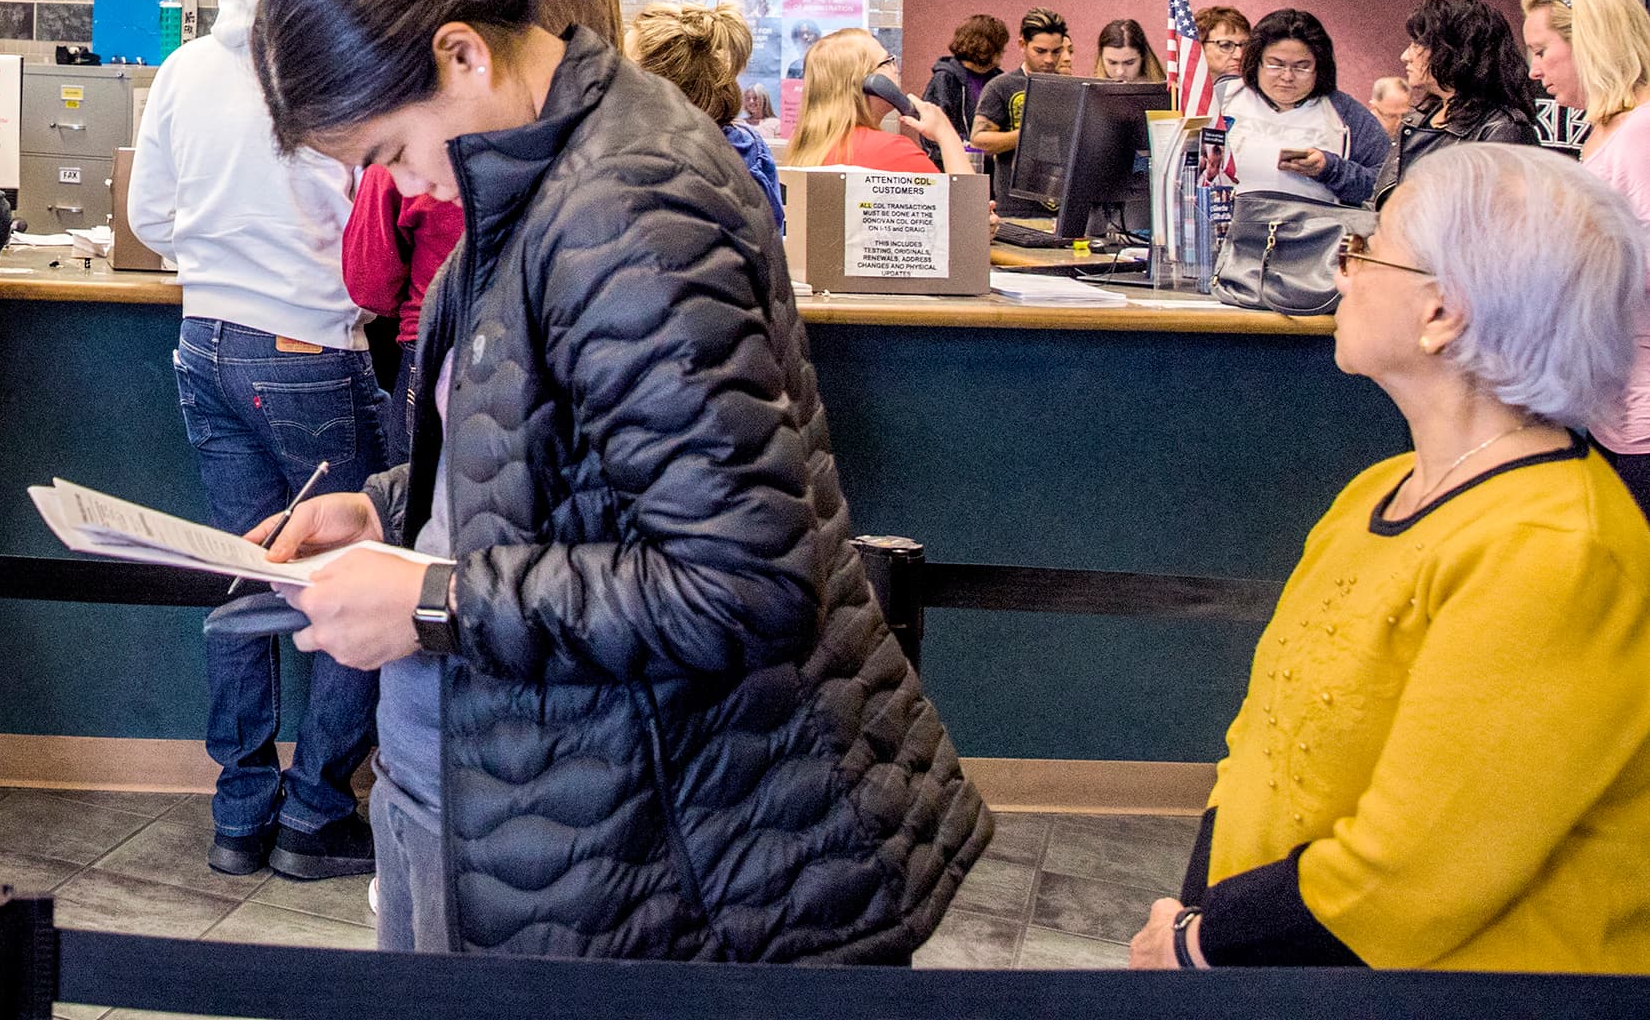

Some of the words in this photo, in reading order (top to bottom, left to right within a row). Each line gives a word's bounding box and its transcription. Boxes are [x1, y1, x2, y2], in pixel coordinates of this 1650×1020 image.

[865, 176, 913, 185] ATTENTION
[914, 177, 931, 185] CDL
[872, 186, 924, 195] CUSTOMERS
[894, 248, 931, 256] ORIGINALS,
